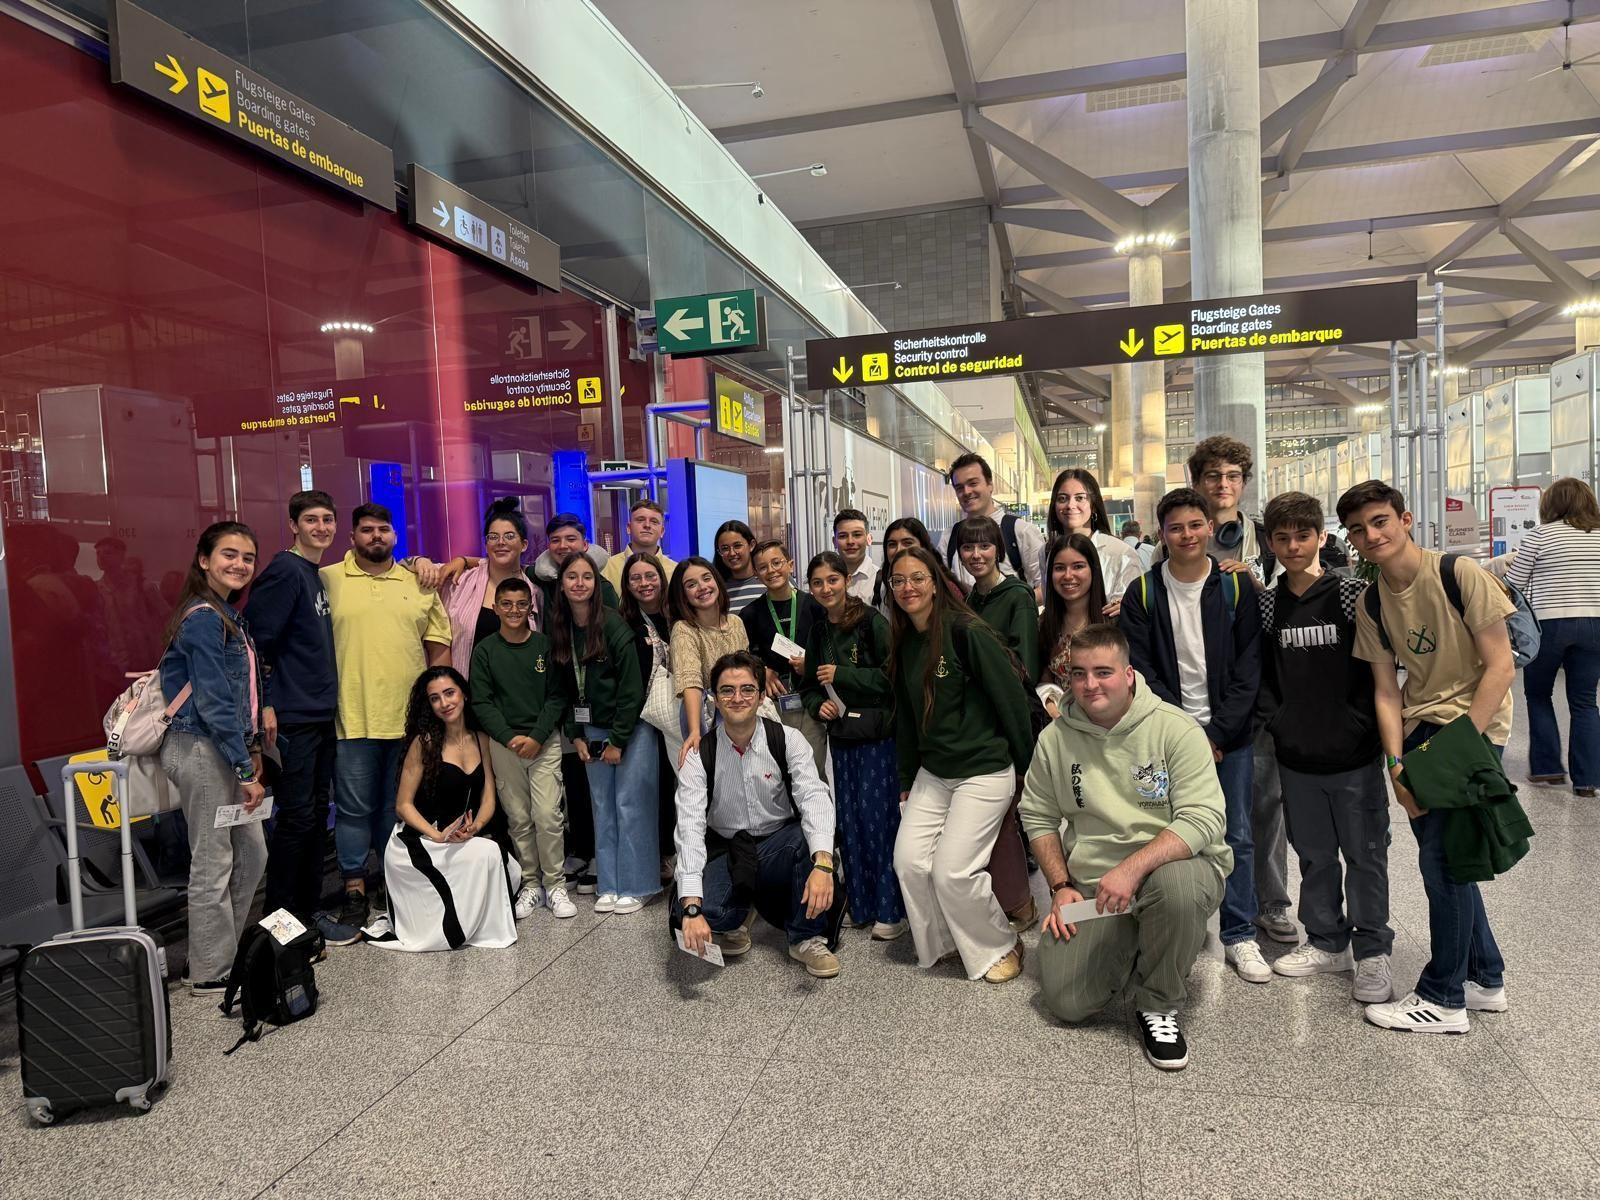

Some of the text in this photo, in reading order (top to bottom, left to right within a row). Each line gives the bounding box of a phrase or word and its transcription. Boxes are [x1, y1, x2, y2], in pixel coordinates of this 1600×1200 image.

[235, 70, 316, 127] Flugsteige Gates
[237, 91, 310, 141] Boarding gates
[238, 111, 364, 187] Puertas de embarque
[1191, 304, 1282, 323] Flugsteige Gates
[1191, 319, 1272, 335] Boarding gates
[893, 332, 987, 351] Sicherheitskontrolle
[1191, 328, 1343, 351] Puertas de embarque
[894, 346, 968, 363] Security control
[895, 354, 1023, 378] Control de seguridad
[1281, 624, 1337, 649] PUMA
